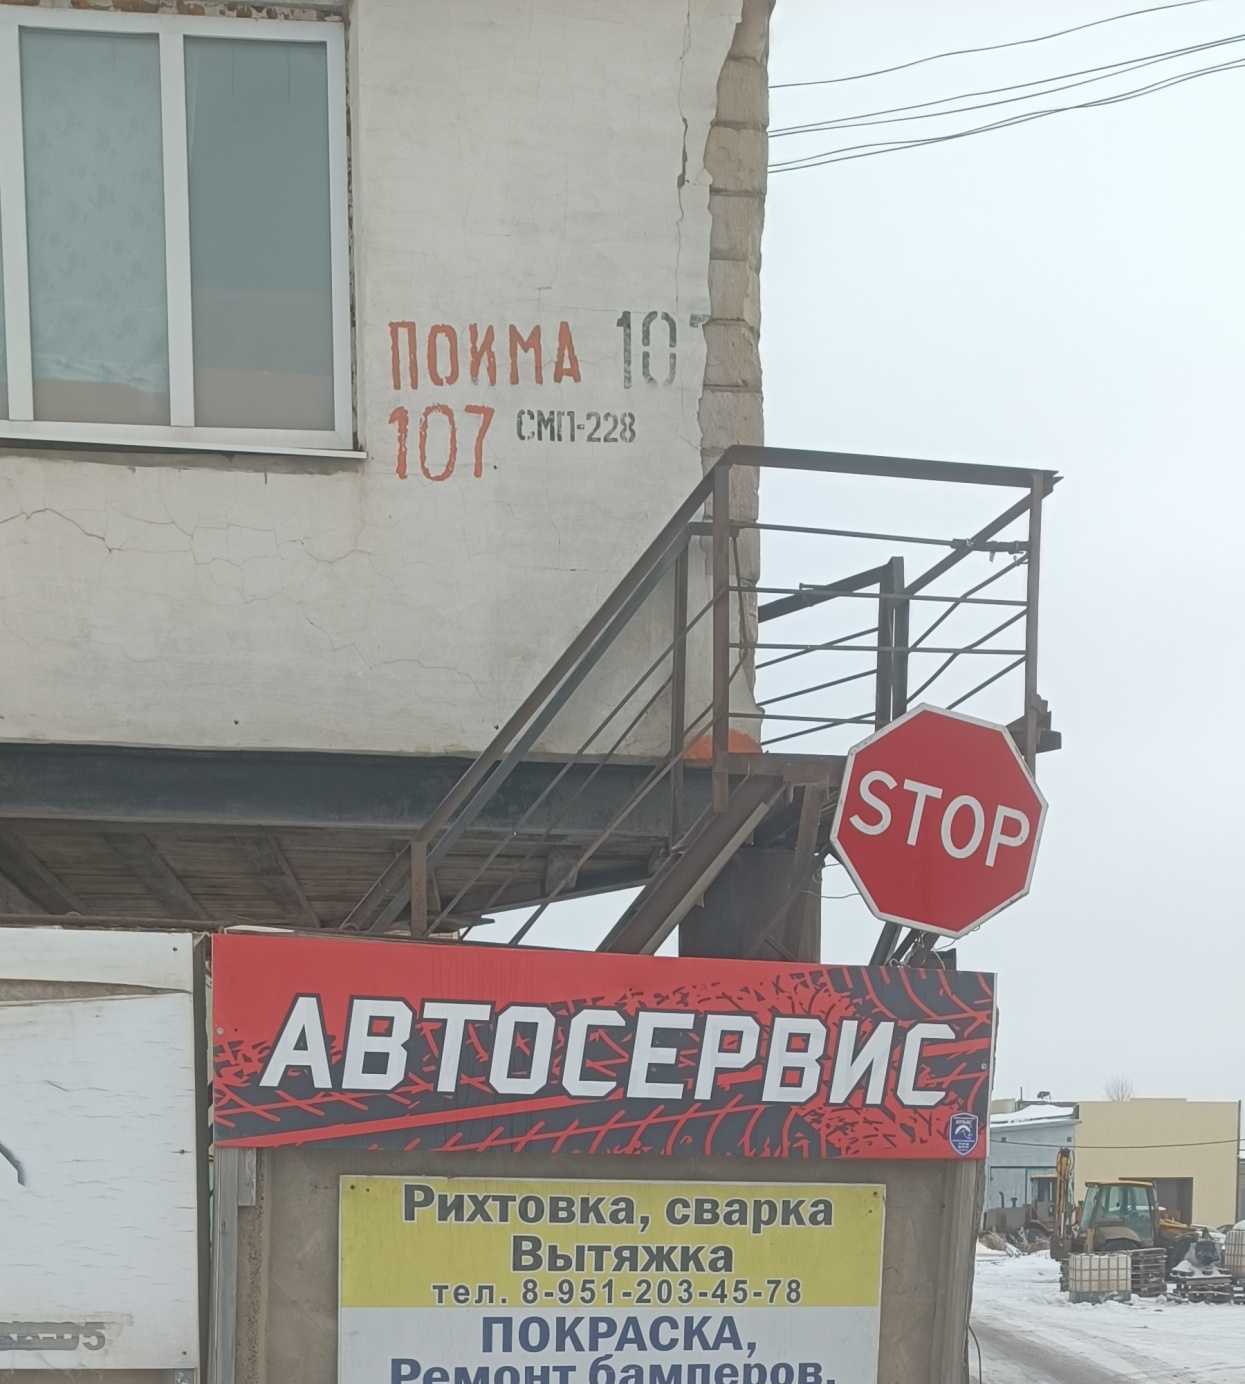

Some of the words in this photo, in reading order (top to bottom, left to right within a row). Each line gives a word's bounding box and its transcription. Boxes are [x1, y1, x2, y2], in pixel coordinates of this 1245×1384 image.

[388, 402, 495, 481] 107
[516, 408, 636, 443] СМП-228
[849, 770, 1031, 868] STOP
[259, 996, 956, 1107] АВТОСЕРВИС
[403, 1183, 651, 1233] Рихтовка,
[665, 1194, 834, 1234] сварка
[511, 1234, 734, 1274] Вытяжка
[432, 1283, 509, 1305] тел.
[521, 1279, 803, 1305] 8-951-203-45-78
[481, 1315, 757, 1357] ПОКРАСКА,
